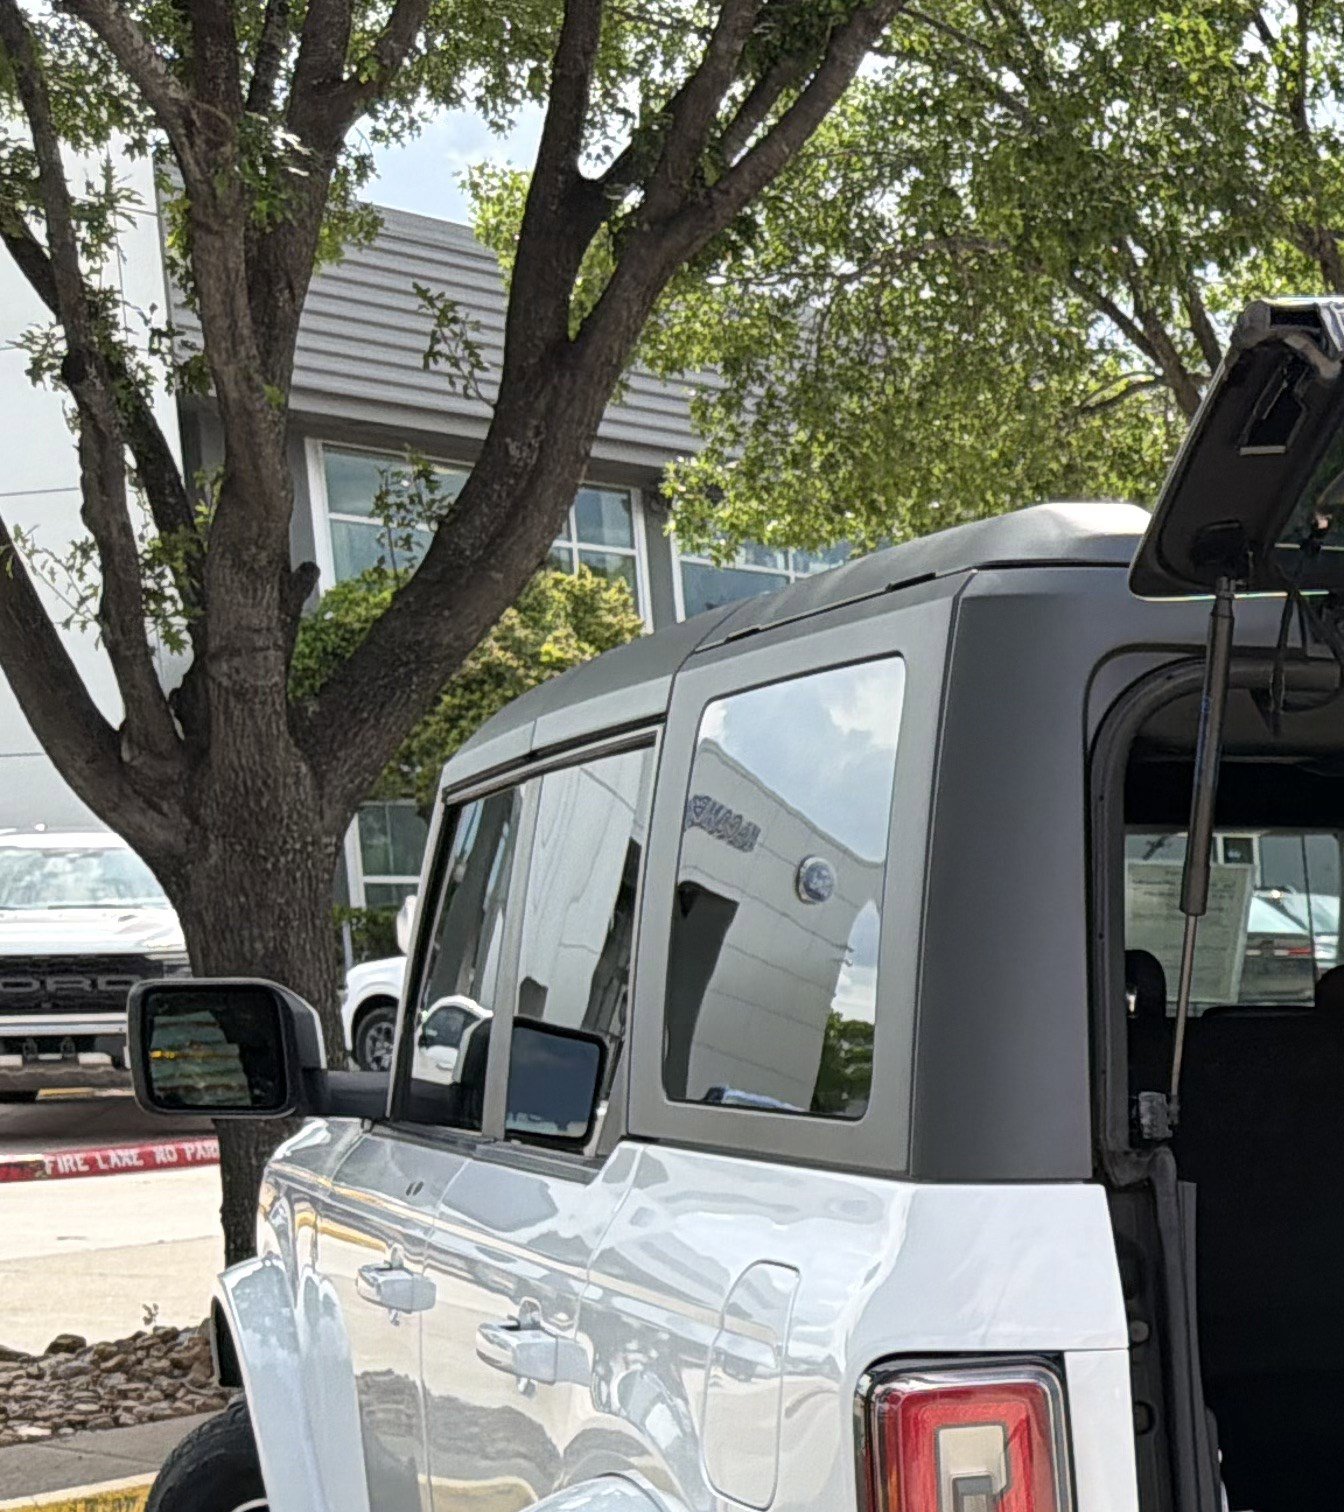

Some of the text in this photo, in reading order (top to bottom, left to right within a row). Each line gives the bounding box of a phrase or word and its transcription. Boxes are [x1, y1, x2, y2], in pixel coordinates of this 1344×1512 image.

[42, 1153, 90, 1175] FIRE
[96, 1149, 144, 1170] LANE
[154, 1145, 178, 1165] NO
